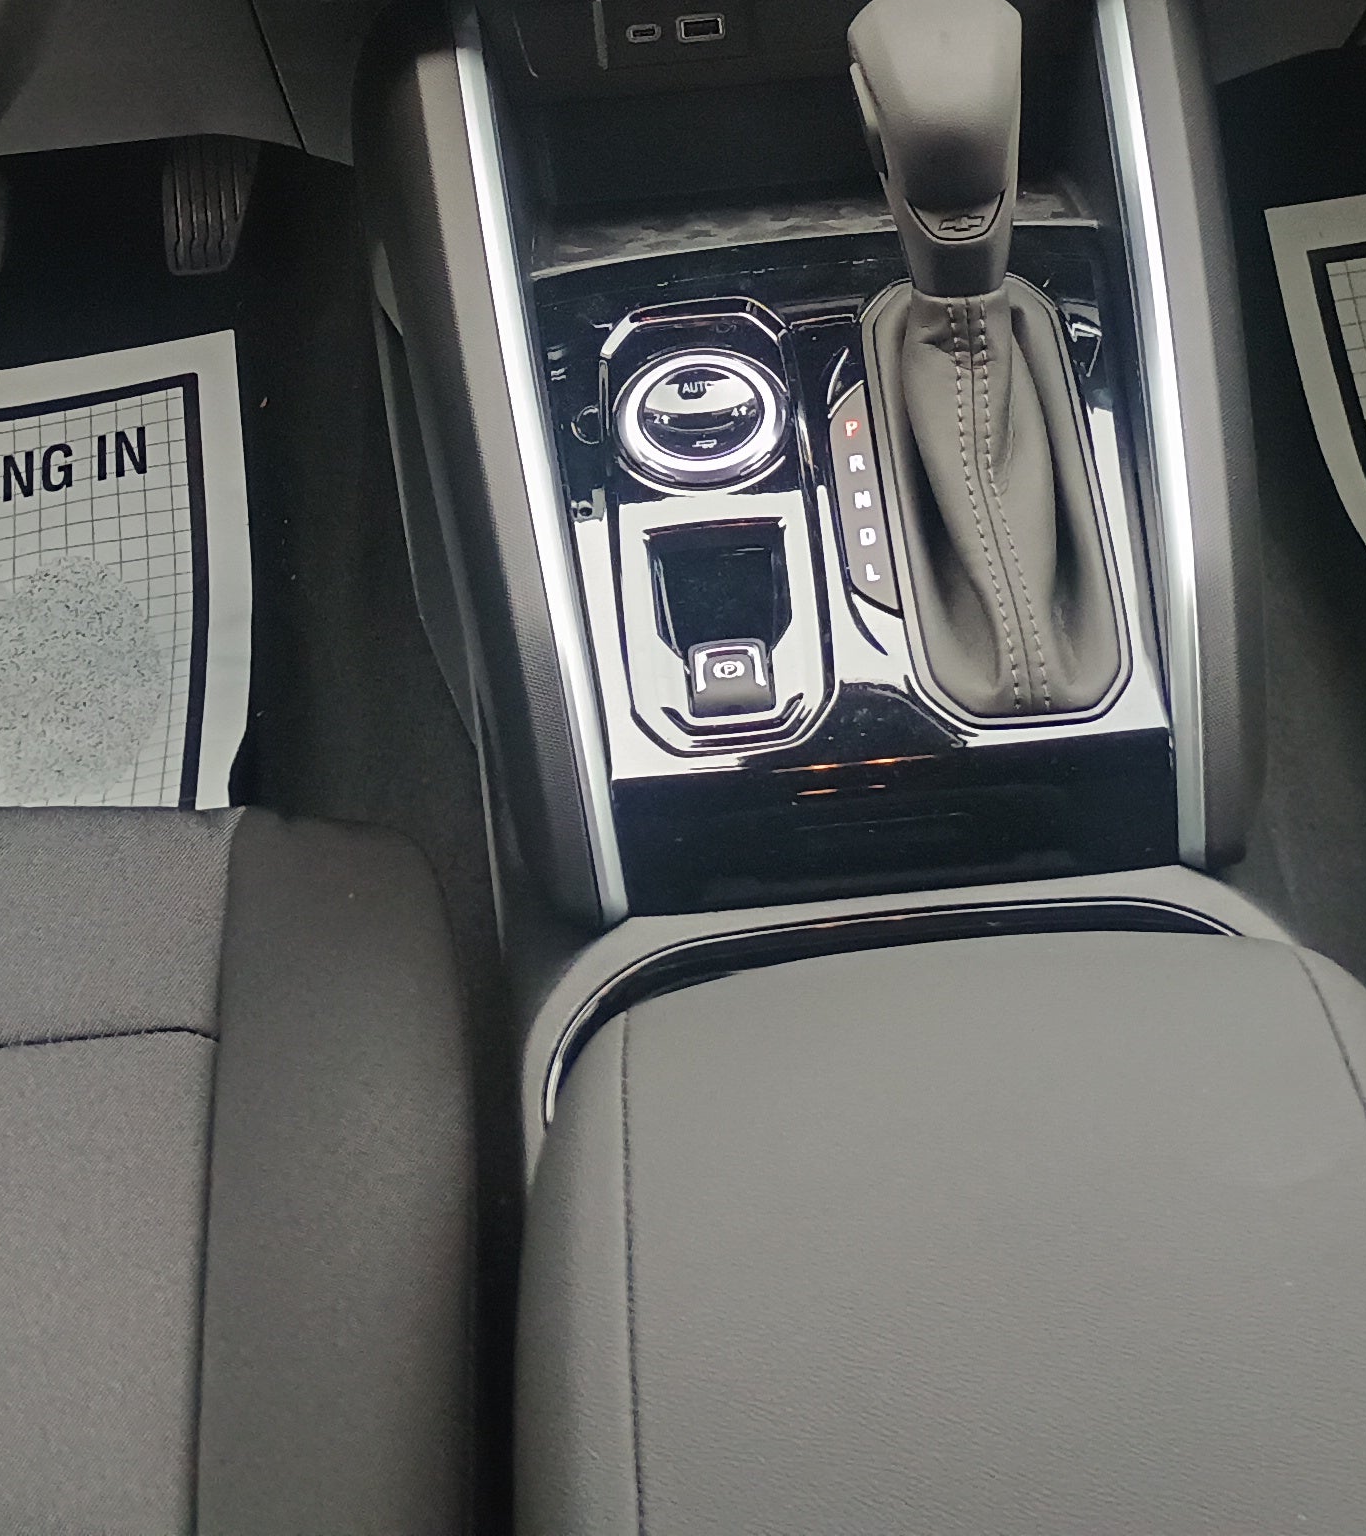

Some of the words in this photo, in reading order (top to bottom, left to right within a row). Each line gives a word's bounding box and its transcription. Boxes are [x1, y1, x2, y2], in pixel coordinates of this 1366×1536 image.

[682, 380, 713, 394] AUT
[845, 420, 858, 437] P
[95, 425, 149, 482] IN
[849, 454, 866, 473] R
[854, 490, 872, 509] N
[859, 527, 877, 546] D
[865, 563, 881, 582] L
